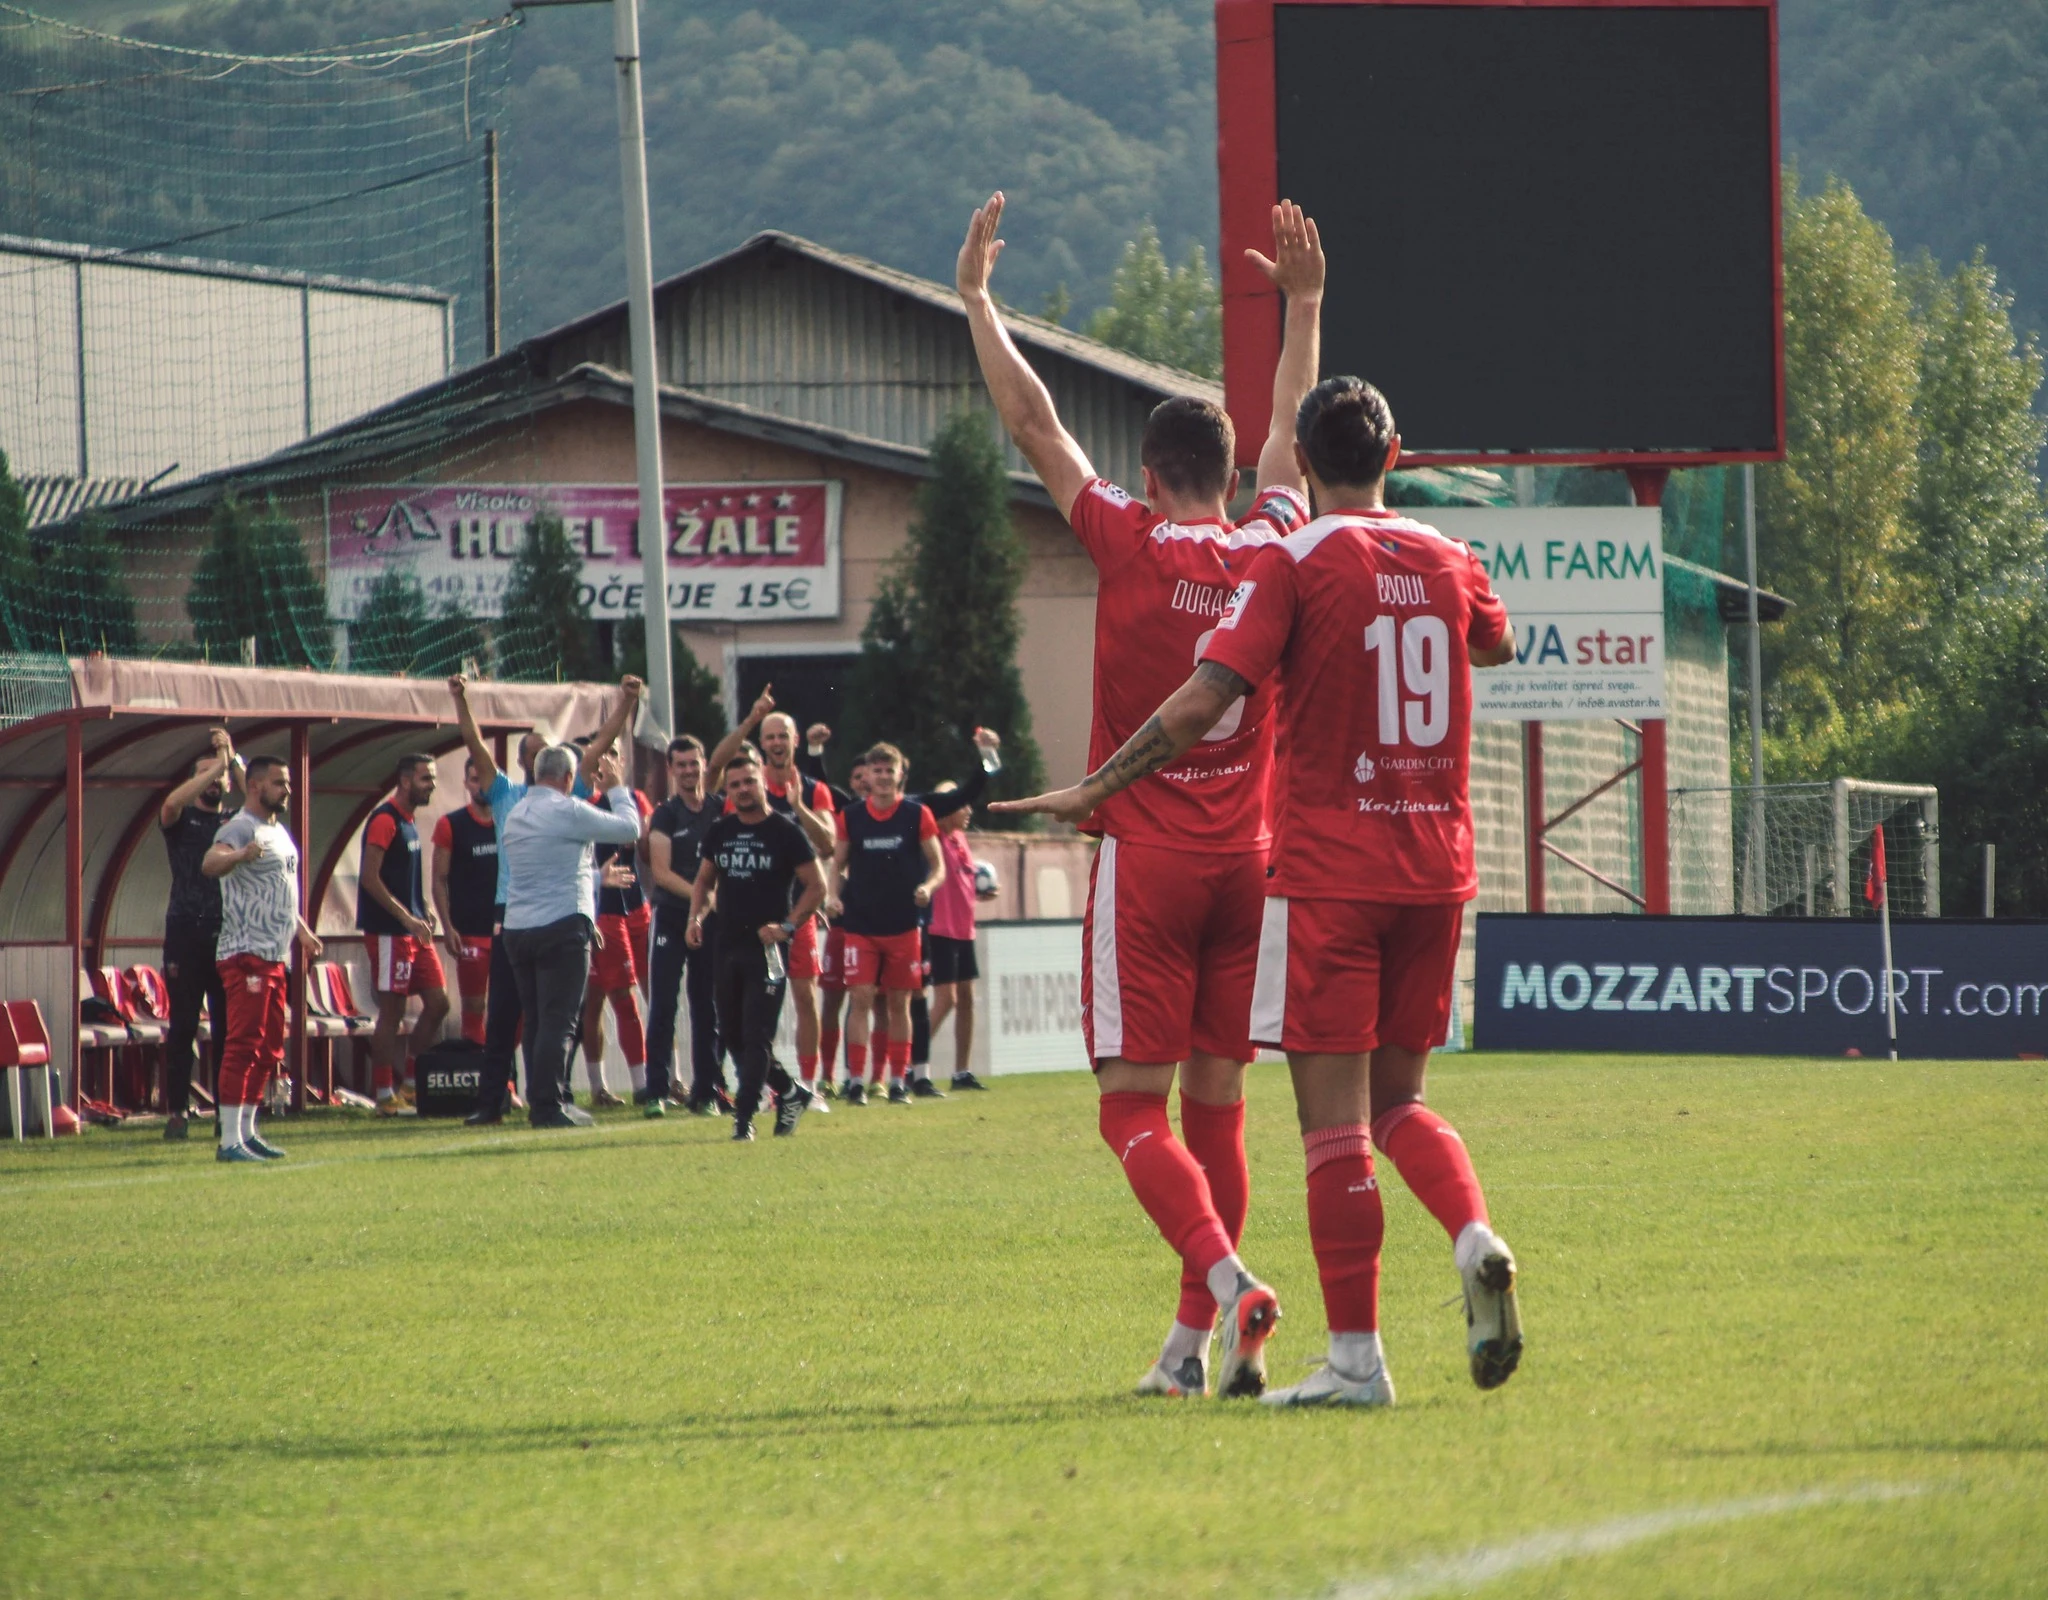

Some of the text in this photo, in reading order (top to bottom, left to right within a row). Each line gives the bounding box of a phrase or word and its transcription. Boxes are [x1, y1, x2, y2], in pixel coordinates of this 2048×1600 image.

[454, 492, 533, 511] Visoko
[452, 507, 801, 557] HOEL ŽALE
[1546, 540, 1656, 580] FARM
[574, 575, 812, 611] OČEJE 15€
[1512, 624, 1654, 665] VA star
[1364, 615, 1450, 748] 19
[1573, 680, 1604, 694] ispred
[1502, 964, 2048, 1017] MOZZARTSPORT.com
[427, 1072, 481, 1089] SELECT
